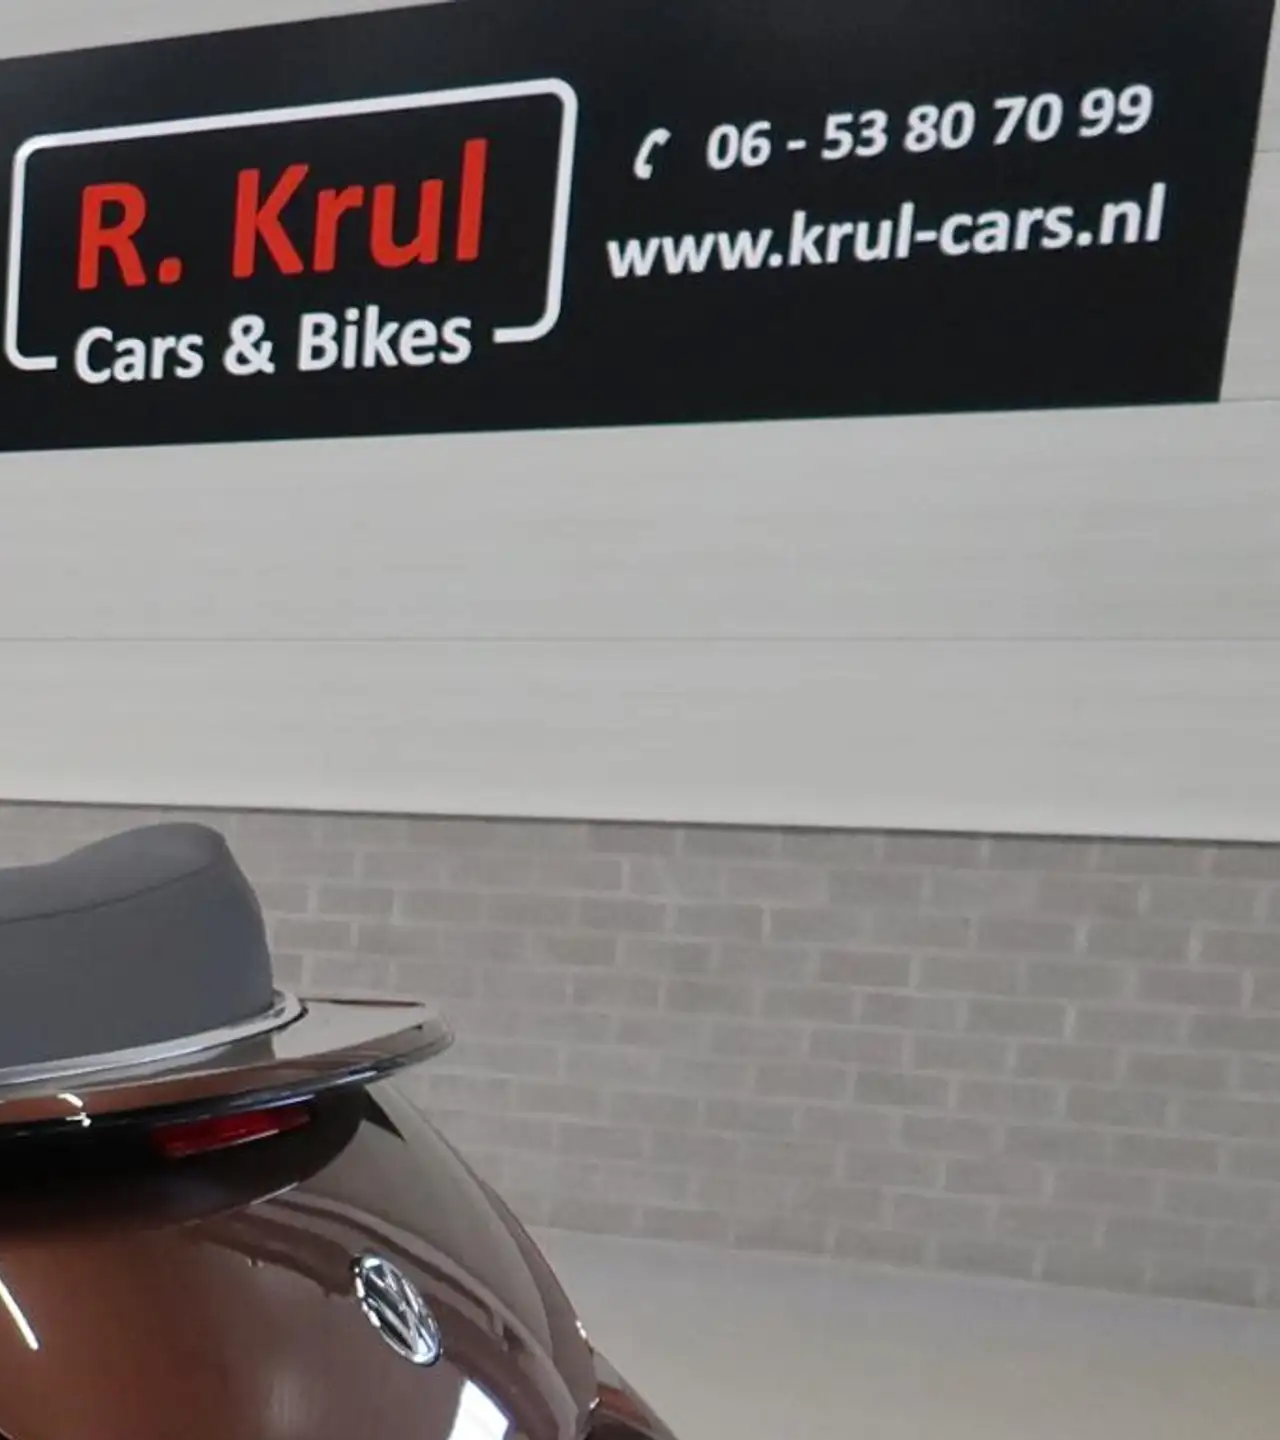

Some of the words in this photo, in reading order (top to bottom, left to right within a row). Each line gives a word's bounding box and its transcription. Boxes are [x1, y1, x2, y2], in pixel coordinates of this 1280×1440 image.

[706, 119, 772, 170] 06
[821, 108, 888, 160] 53
[903, 101, 976, 153] 80
[993, 92, 1063, 145] 70
[1079, 84, 1153, 138] 99
[74, 181, 184, 291] R.
[230, 138, 489, 280] Krul
[605, 182, 1167, 280] www.krul-cars.nl
[73, 325, 204, 384] Cars
[222, 313, 275, 376] &
[296, 304, 472, 372] Bikes
